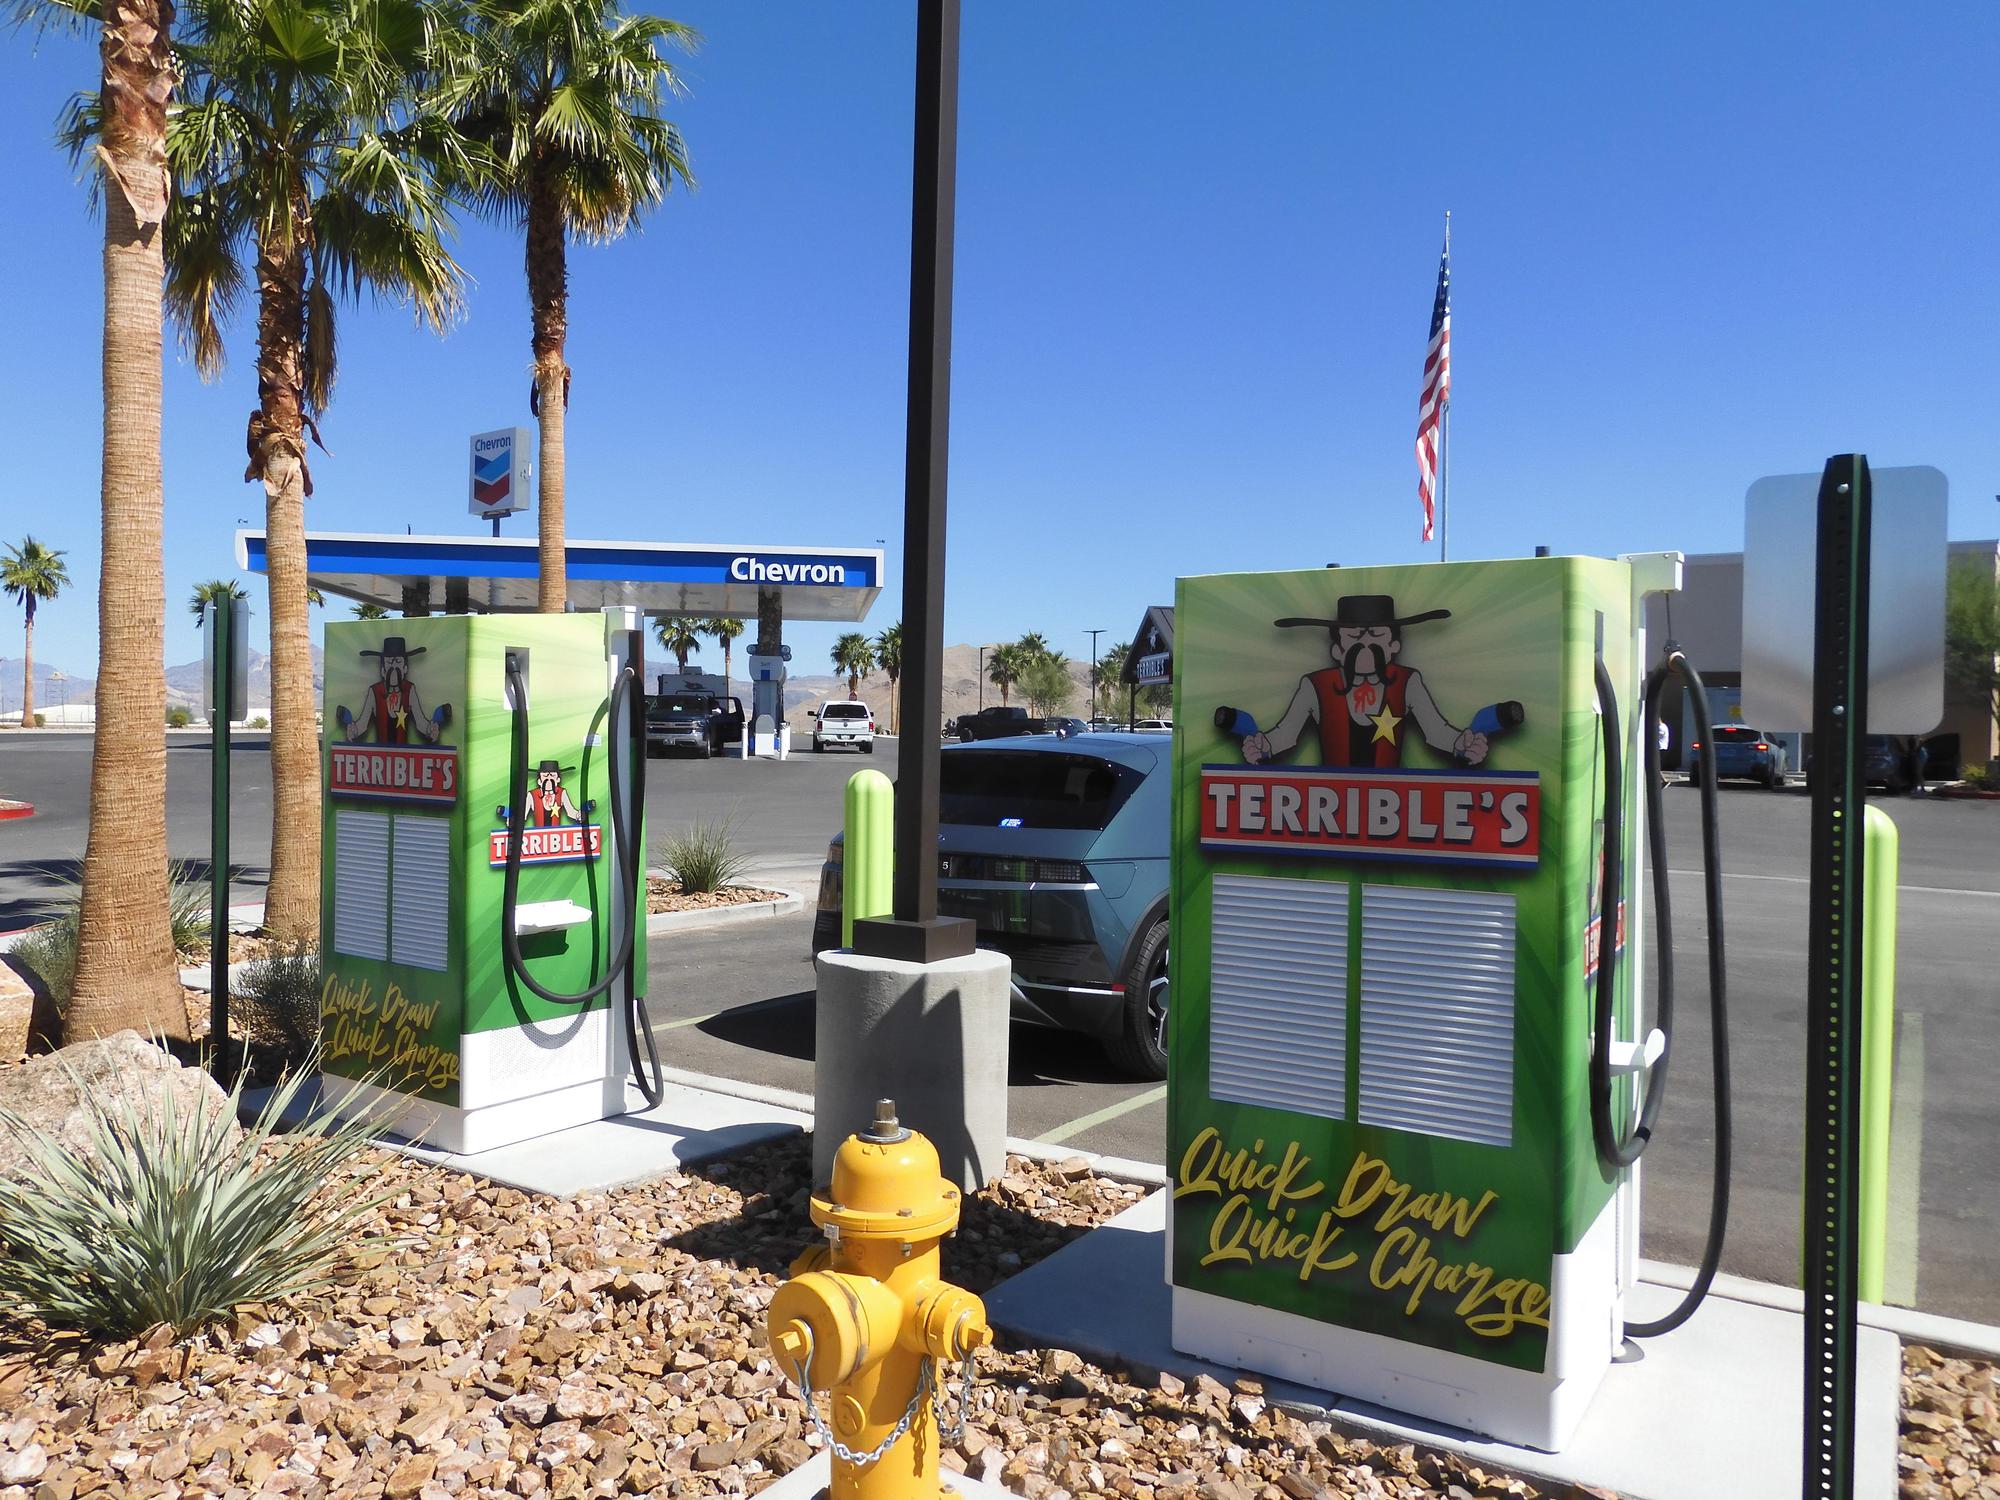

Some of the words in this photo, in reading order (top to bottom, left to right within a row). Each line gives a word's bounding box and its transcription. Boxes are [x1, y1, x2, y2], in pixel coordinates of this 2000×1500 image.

[475, 436, 511, 452] Chevron
[731, 557, 845, 583] Chevron
[334, 754, 453, 790] TERRIBLE'S
[1208, 783, 1529, 845] TERRIBLE'S
[493, 831, 598, 857] TRRIBLE'S
[942, 861, 949, 870] 5
[321, 972, 377, 1022] Quick
[379, 982, 440, 1030] Draw
[330, 1013, 390, 1064] Quick
[394, 1026, 460, 1088] Charge
[1173, 1127, 1325, 1210] Quick
[1331, 1151, 1498, 1237] Draw
[1200, 1193, 1358, 1280] Quick
[1369, 1226, 1551, 1336] Charge
